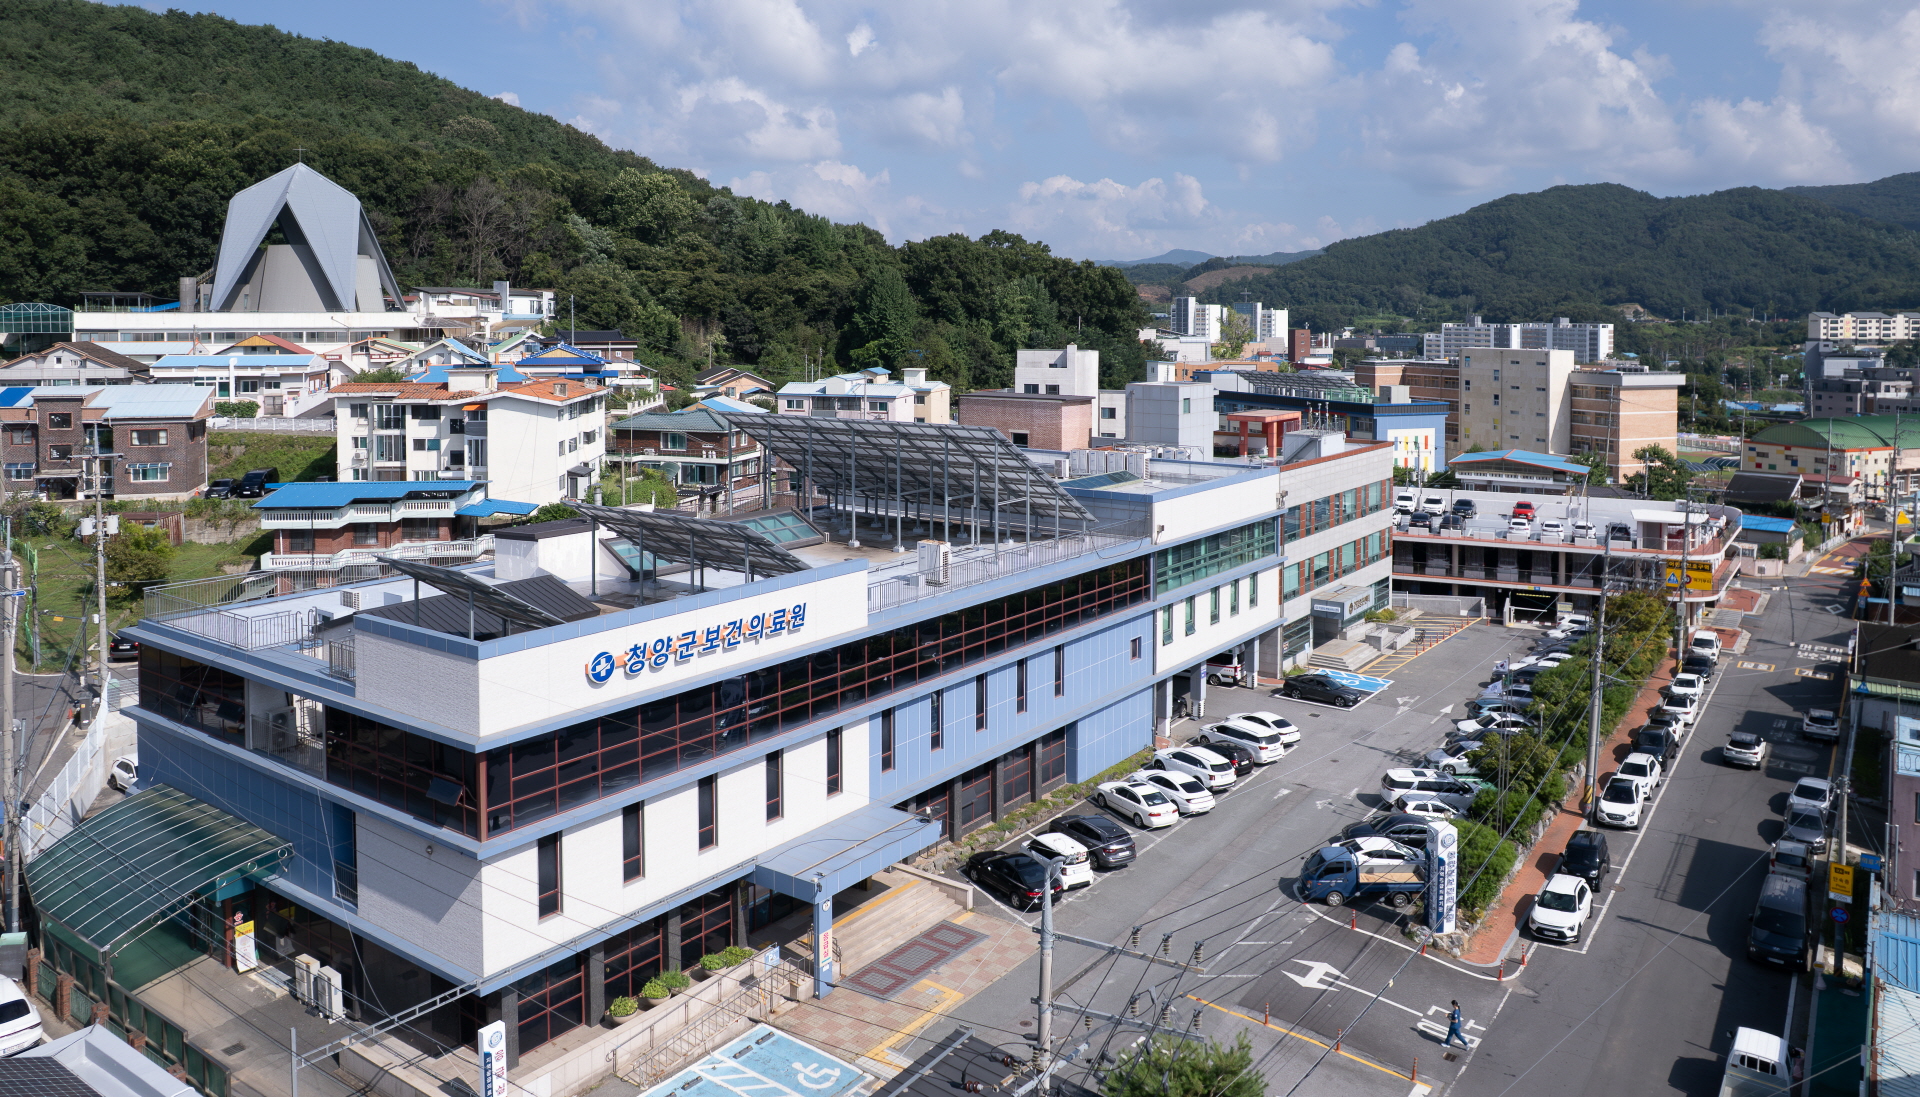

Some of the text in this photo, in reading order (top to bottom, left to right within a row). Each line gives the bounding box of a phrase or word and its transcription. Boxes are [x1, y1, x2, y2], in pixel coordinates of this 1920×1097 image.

[1668, 561, 1710, 570] 어린보호구역
[625, 602, 807, 674] 청양군보건의료원
[1799, 643, 1843, 655] 어린이
[1797, 651, 1842, 663] 보호구역
